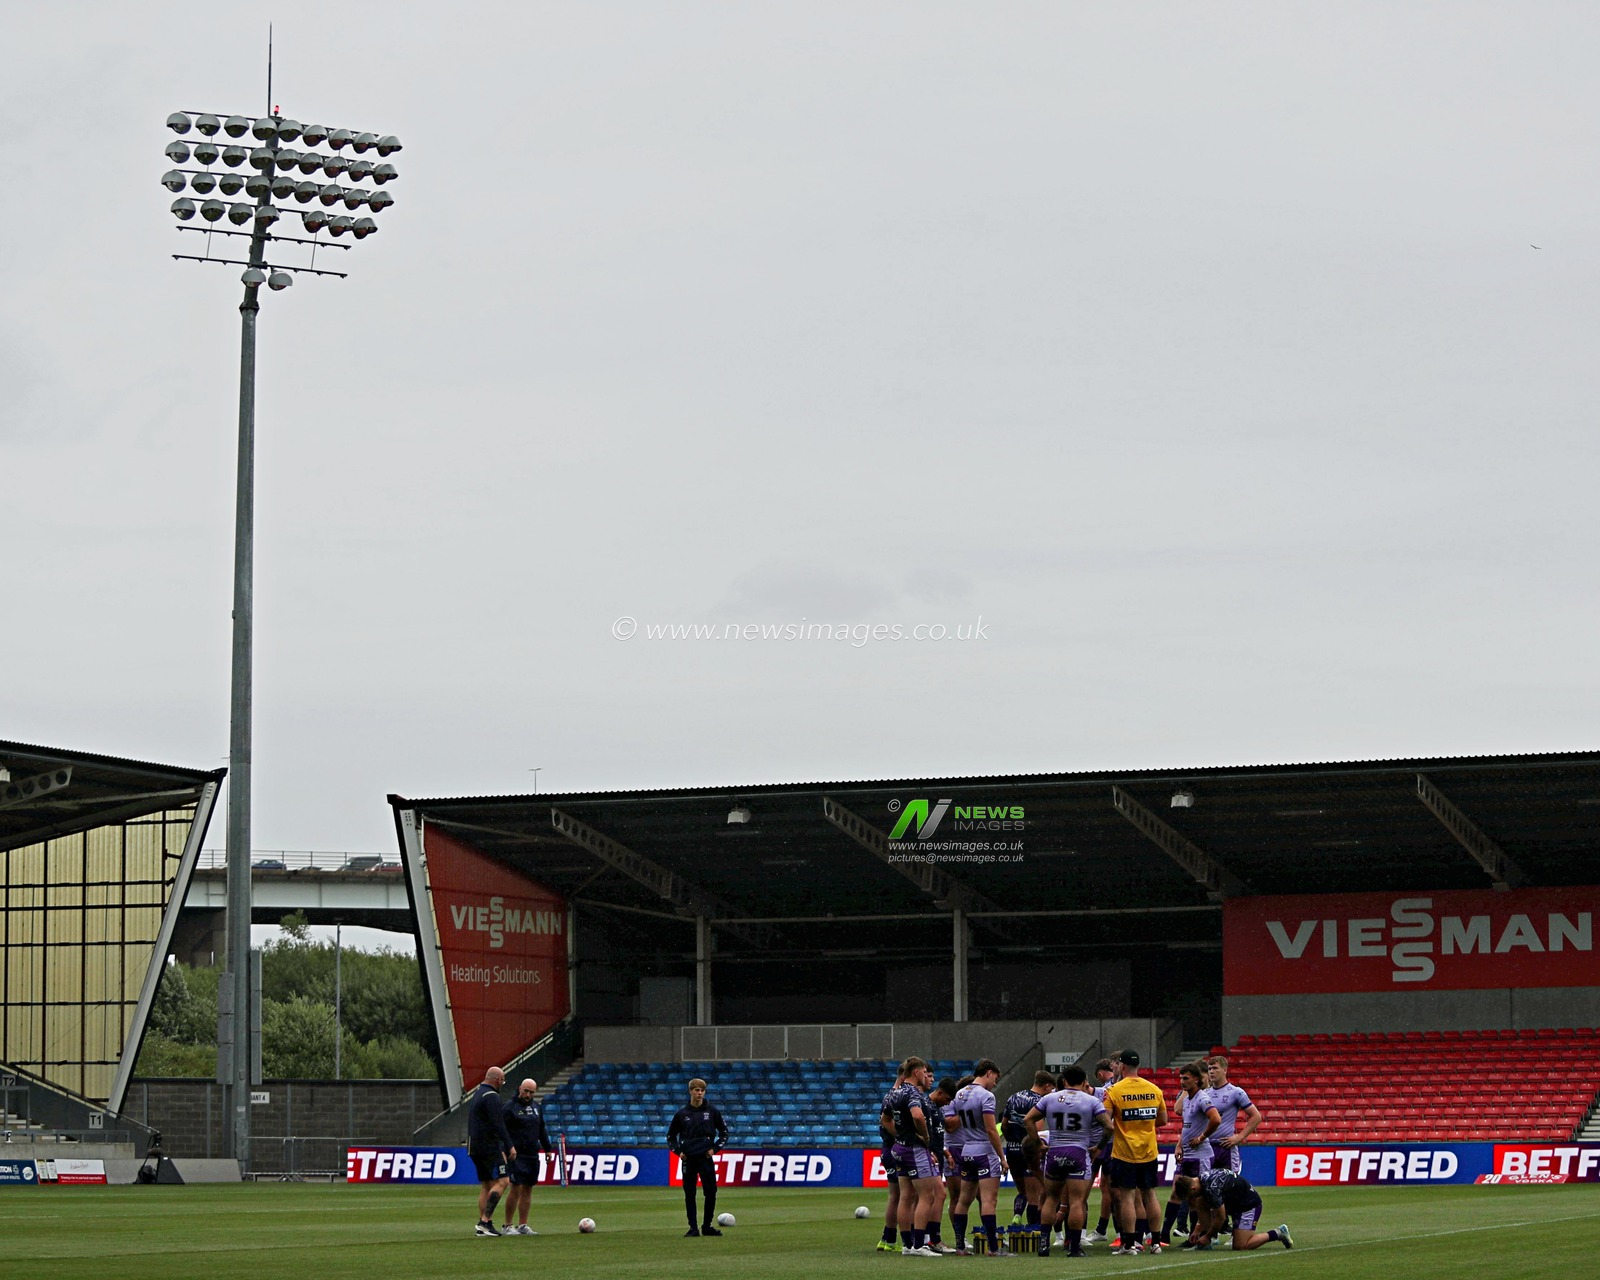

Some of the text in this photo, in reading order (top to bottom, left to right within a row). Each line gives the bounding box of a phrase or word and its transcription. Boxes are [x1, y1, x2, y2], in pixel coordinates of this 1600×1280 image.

[450, 896, 562, 948] VIESSMANN
[451, 963, 541, 987] Heating Solutions
[3, 1077, 15, 1087] T2
[1121, 1093, 1156, 1101] TRAINER
[90, 1115, 103, 1125] T1
[957, 1109, 975, 1129] 11
[1052, 1112, 1082, 1131] 13
[1283, 1150, 1458, 1182] BETFRED
[1501, 1147, 1600, 1178] BETF
[1481, 1174, 1502, 1184] 20
